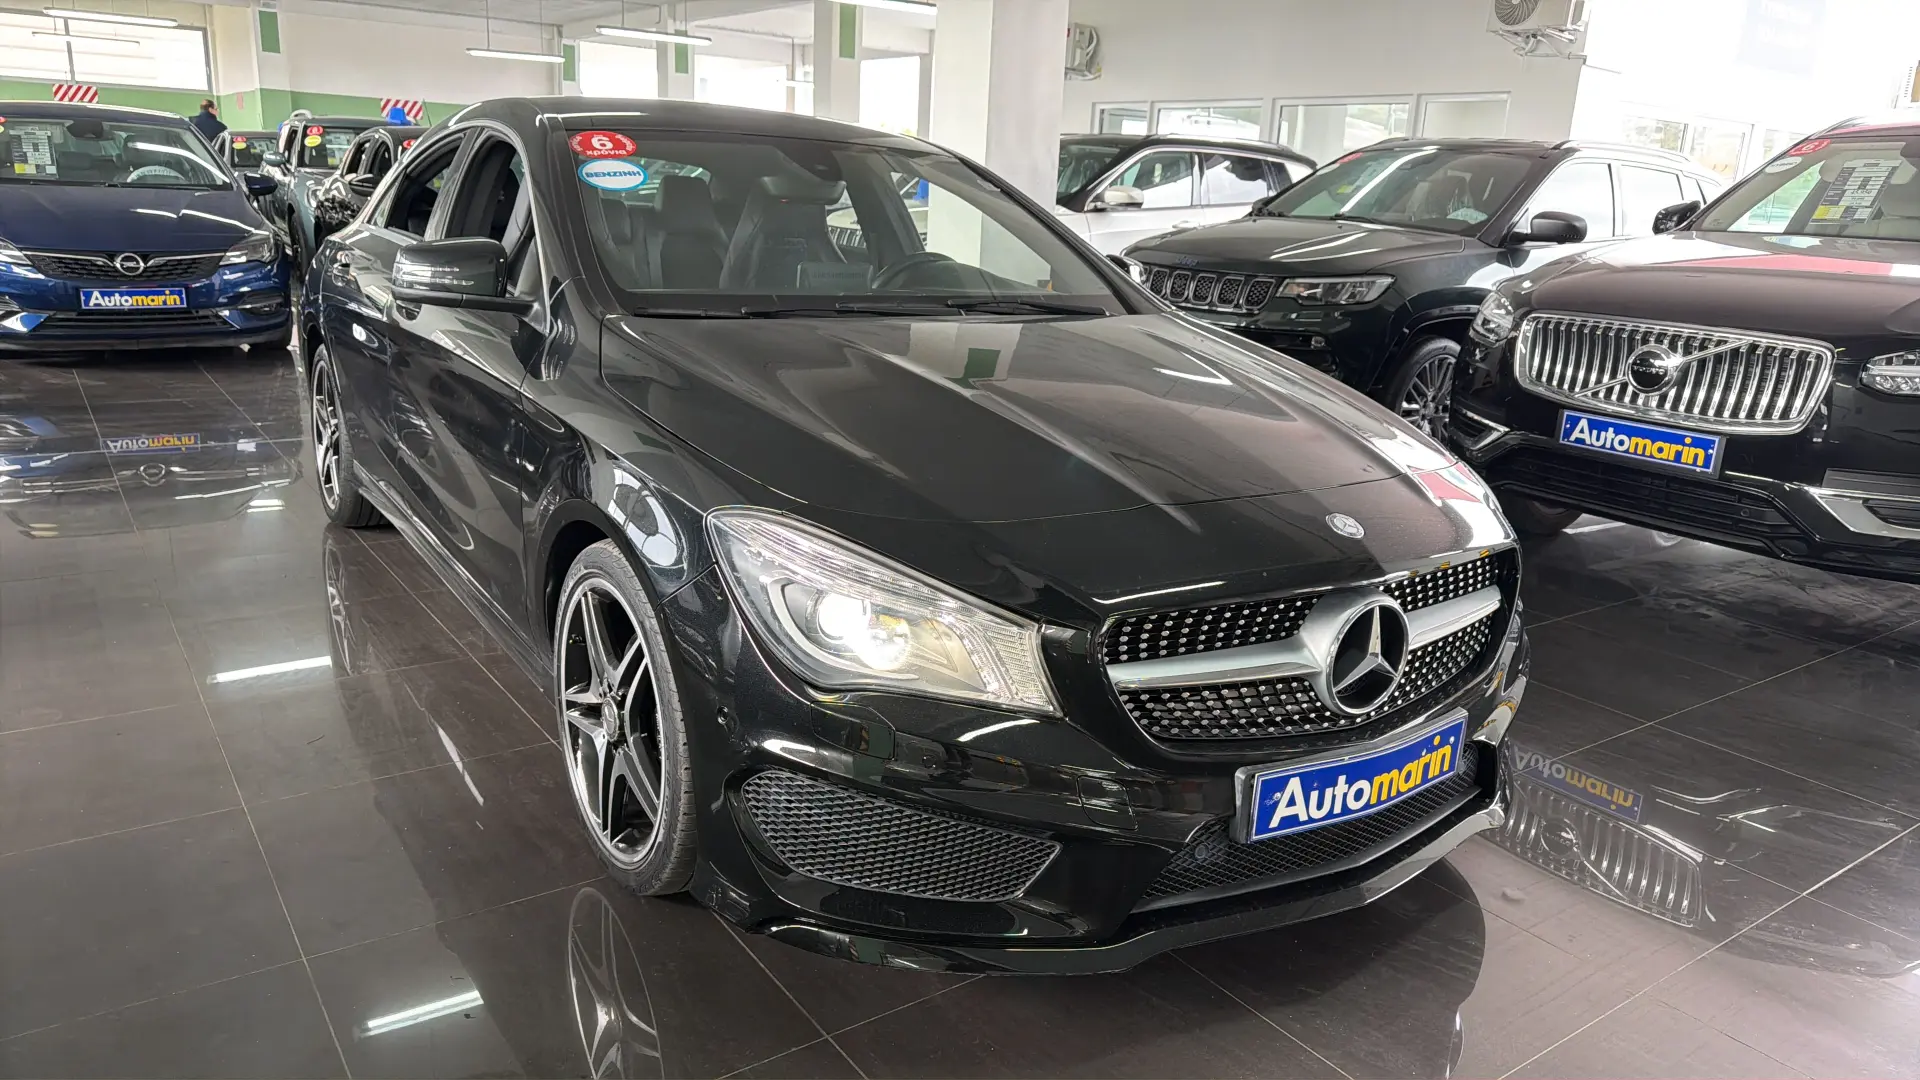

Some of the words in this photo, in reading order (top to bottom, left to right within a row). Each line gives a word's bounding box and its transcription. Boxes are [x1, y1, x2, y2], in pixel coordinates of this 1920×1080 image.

[591, 136, 614, 150] 6
[88, 290, 180, 306] Automarin
[1569, 418, 1705, 467] Automarin
[1268, 735, 1452, 829] Automarin
